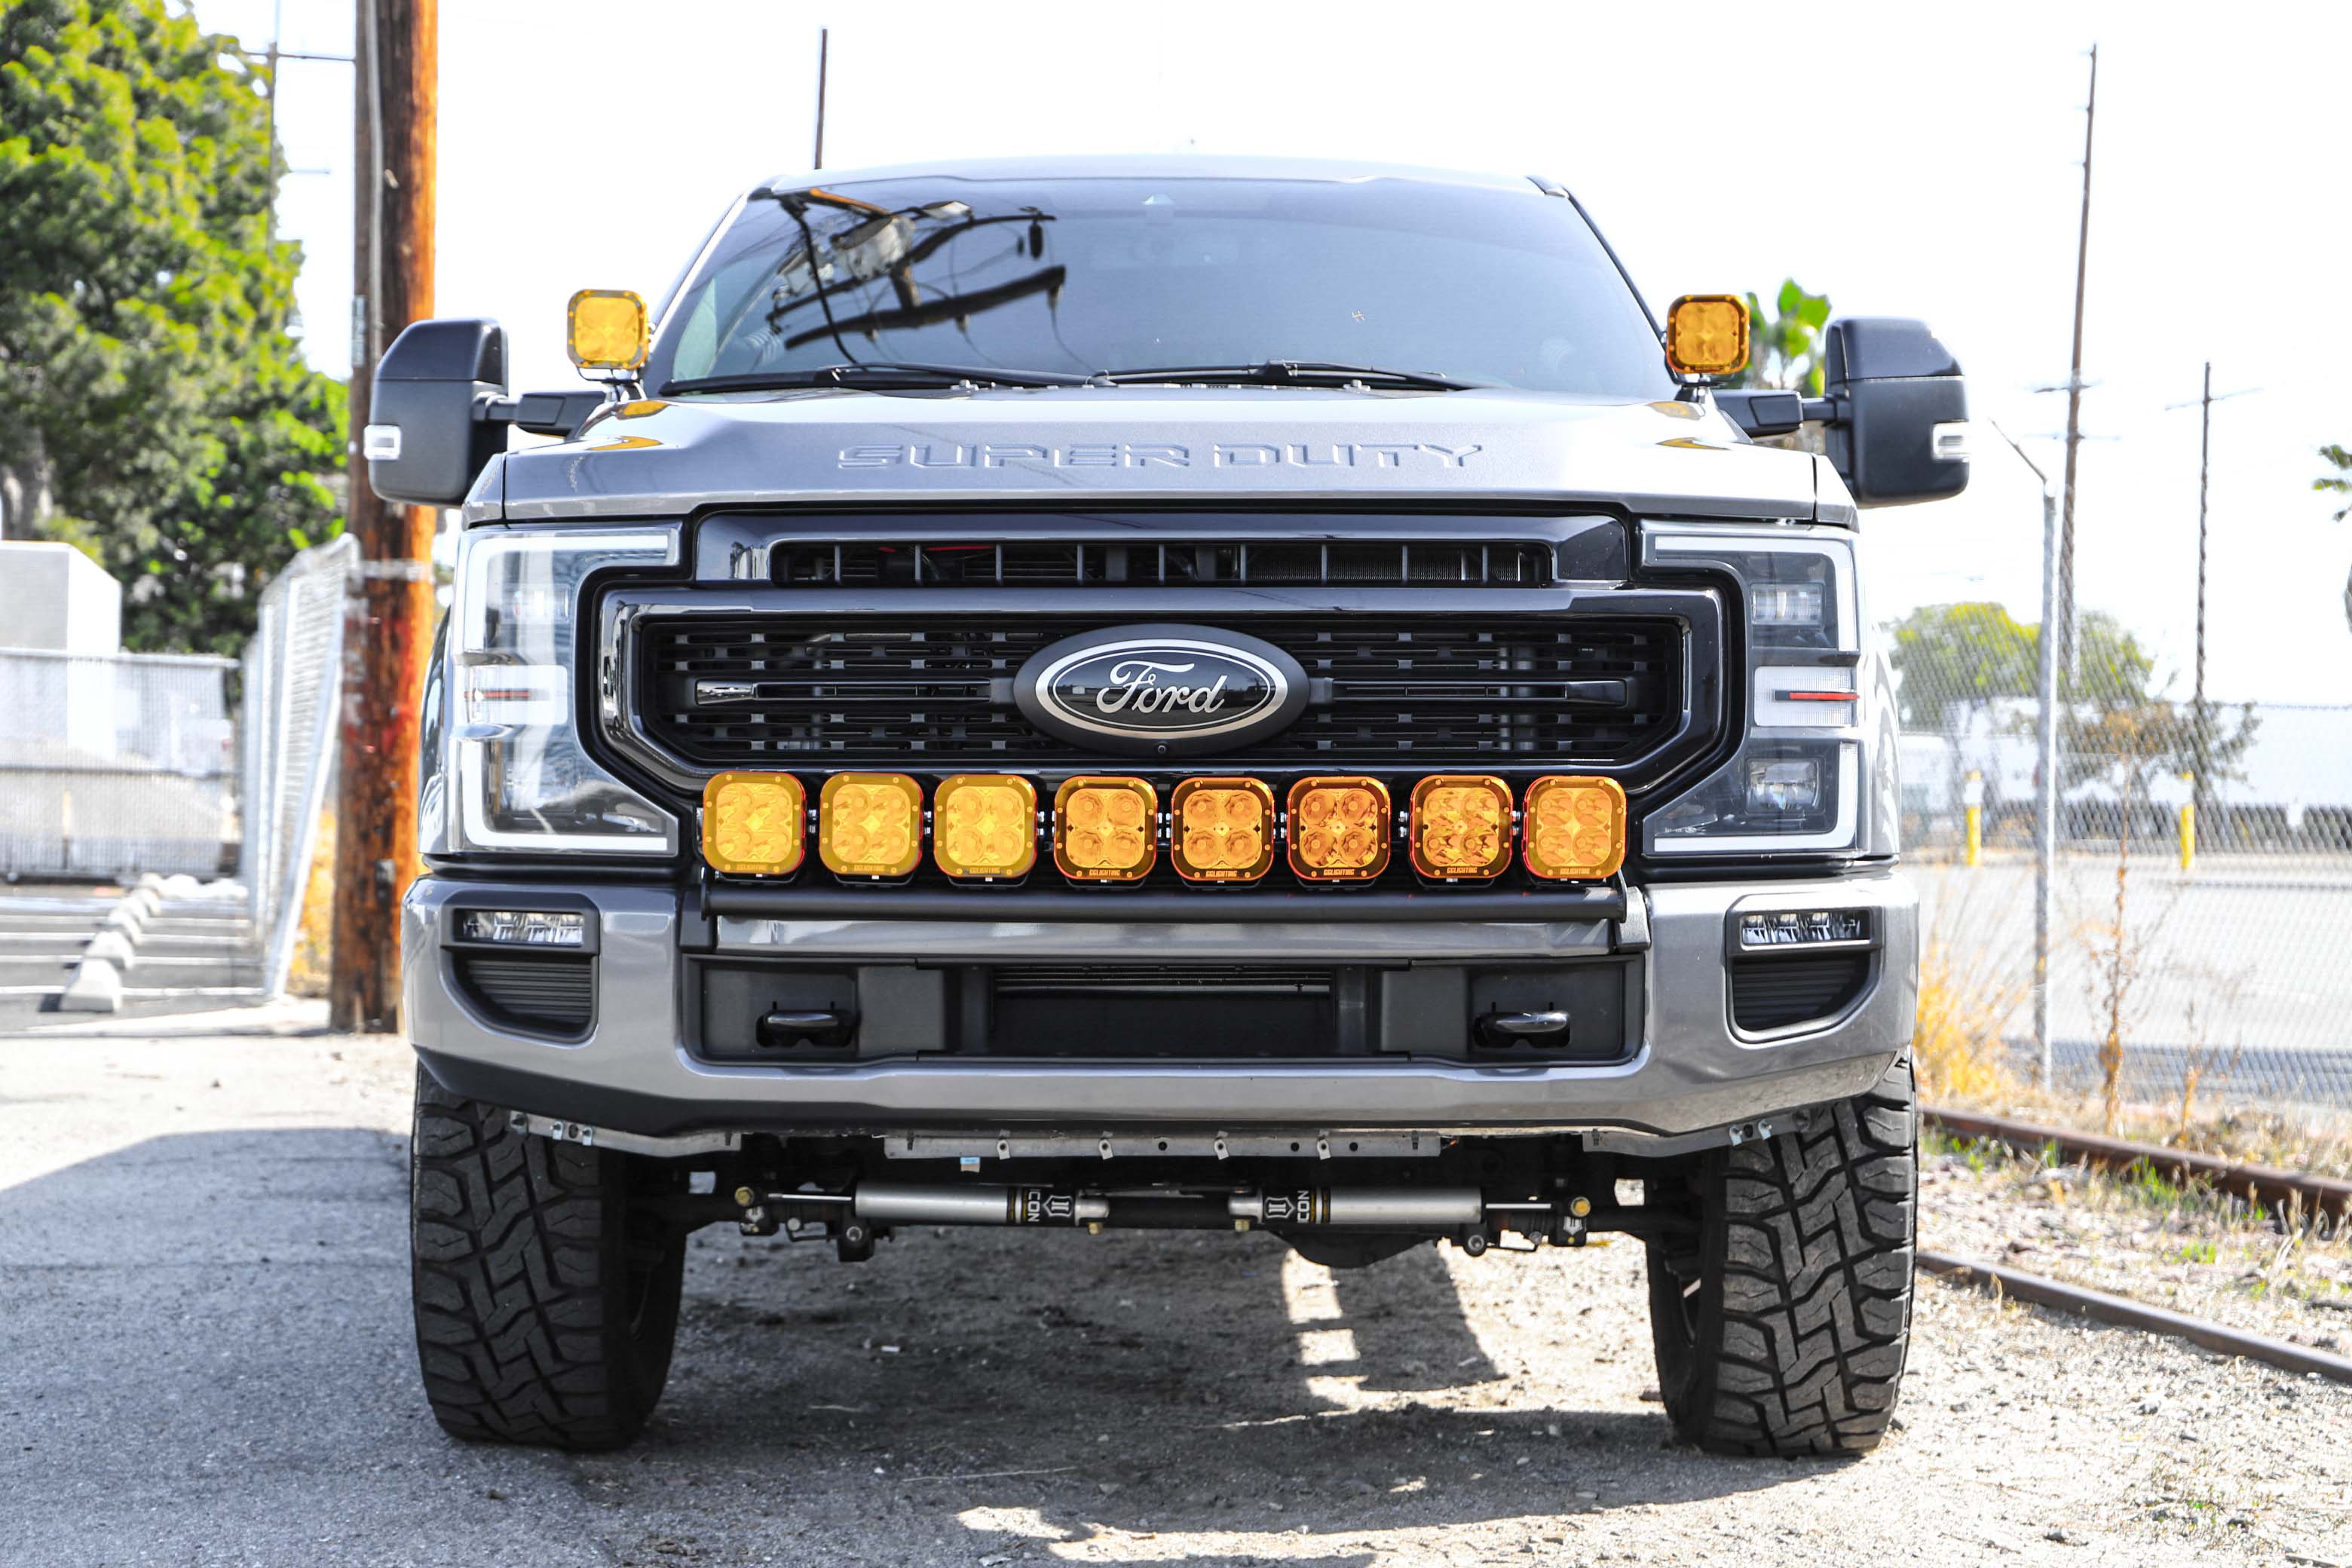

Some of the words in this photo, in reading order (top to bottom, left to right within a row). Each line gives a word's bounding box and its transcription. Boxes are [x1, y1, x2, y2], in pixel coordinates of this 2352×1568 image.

[838, 443, 1190, 469] SUPER
[1213, 442, 1484, 469] DUTY
[1095, 660, 1229, 714] Ford
[1027, 1188, 1041, 1223] ICON
[1297, 1190, 1310, 1223] ICON
